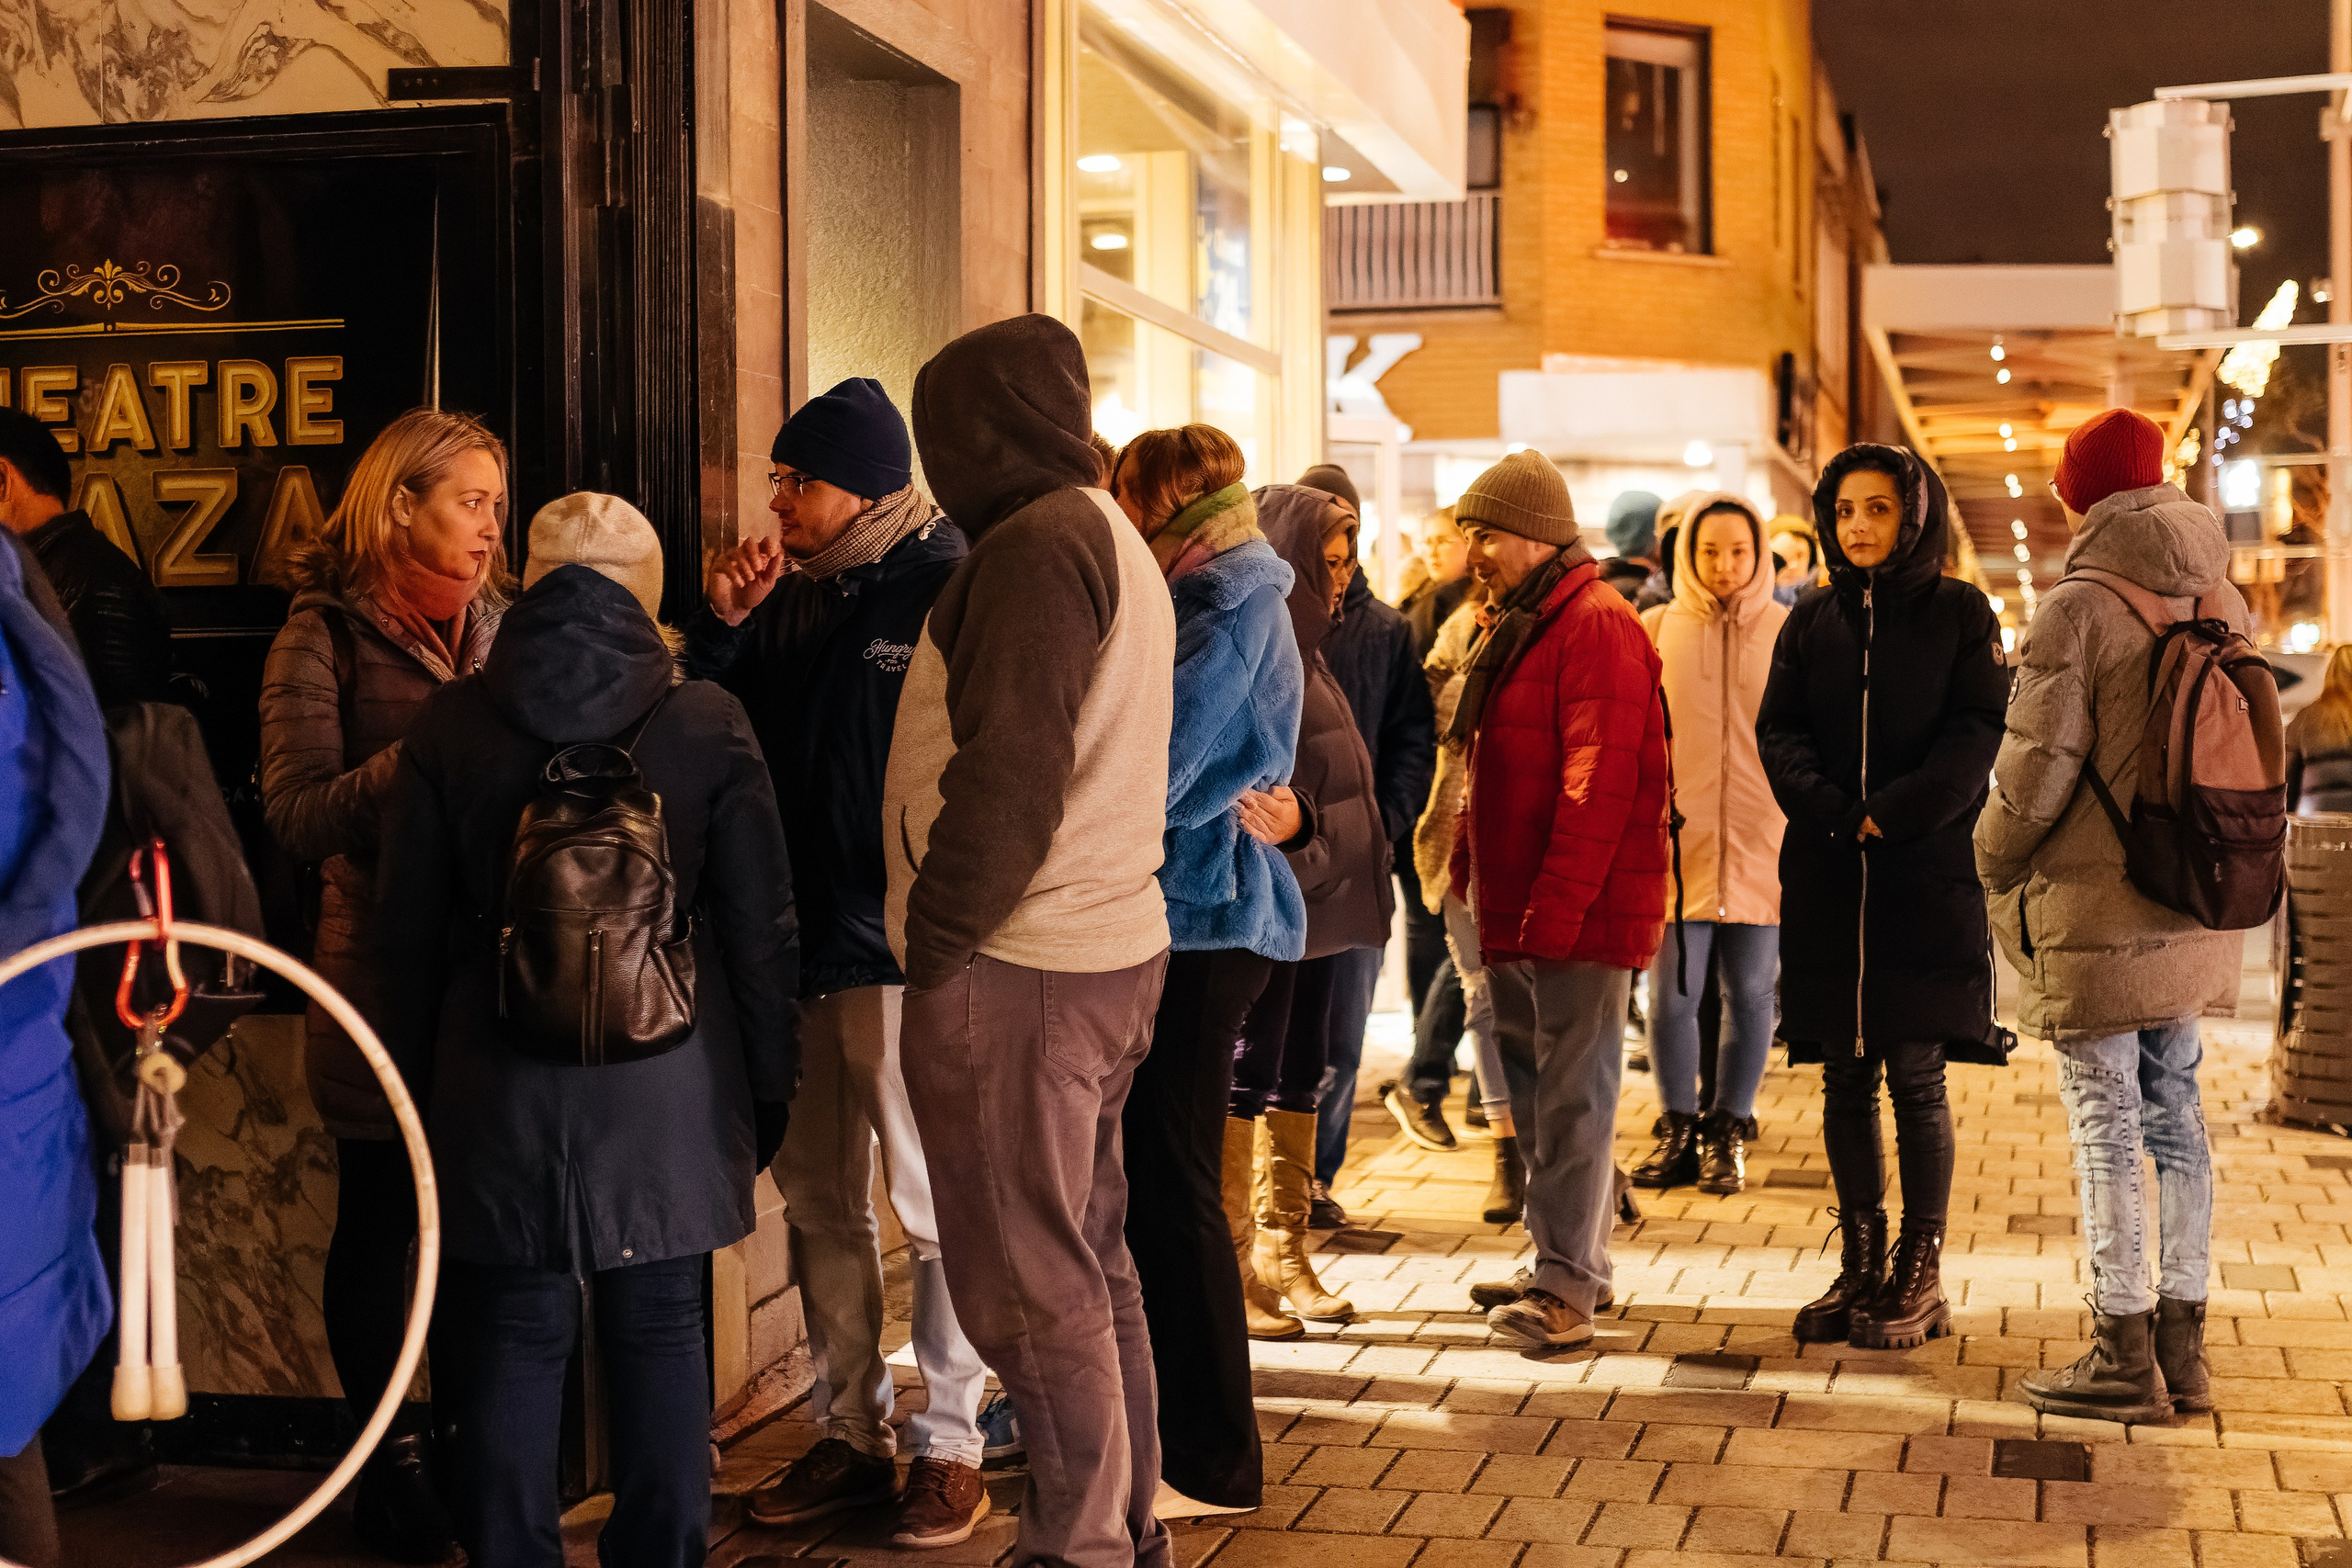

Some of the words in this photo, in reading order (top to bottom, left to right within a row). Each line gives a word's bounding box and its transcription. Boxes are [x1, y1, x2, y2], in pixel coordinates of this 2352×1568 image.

[0, 355, 344, 452] EATRE
[69, 465, 326, 588] AZA
[863, 637, 916, 660] Hungry
[876, 659, 908, 672] TRAVEL
